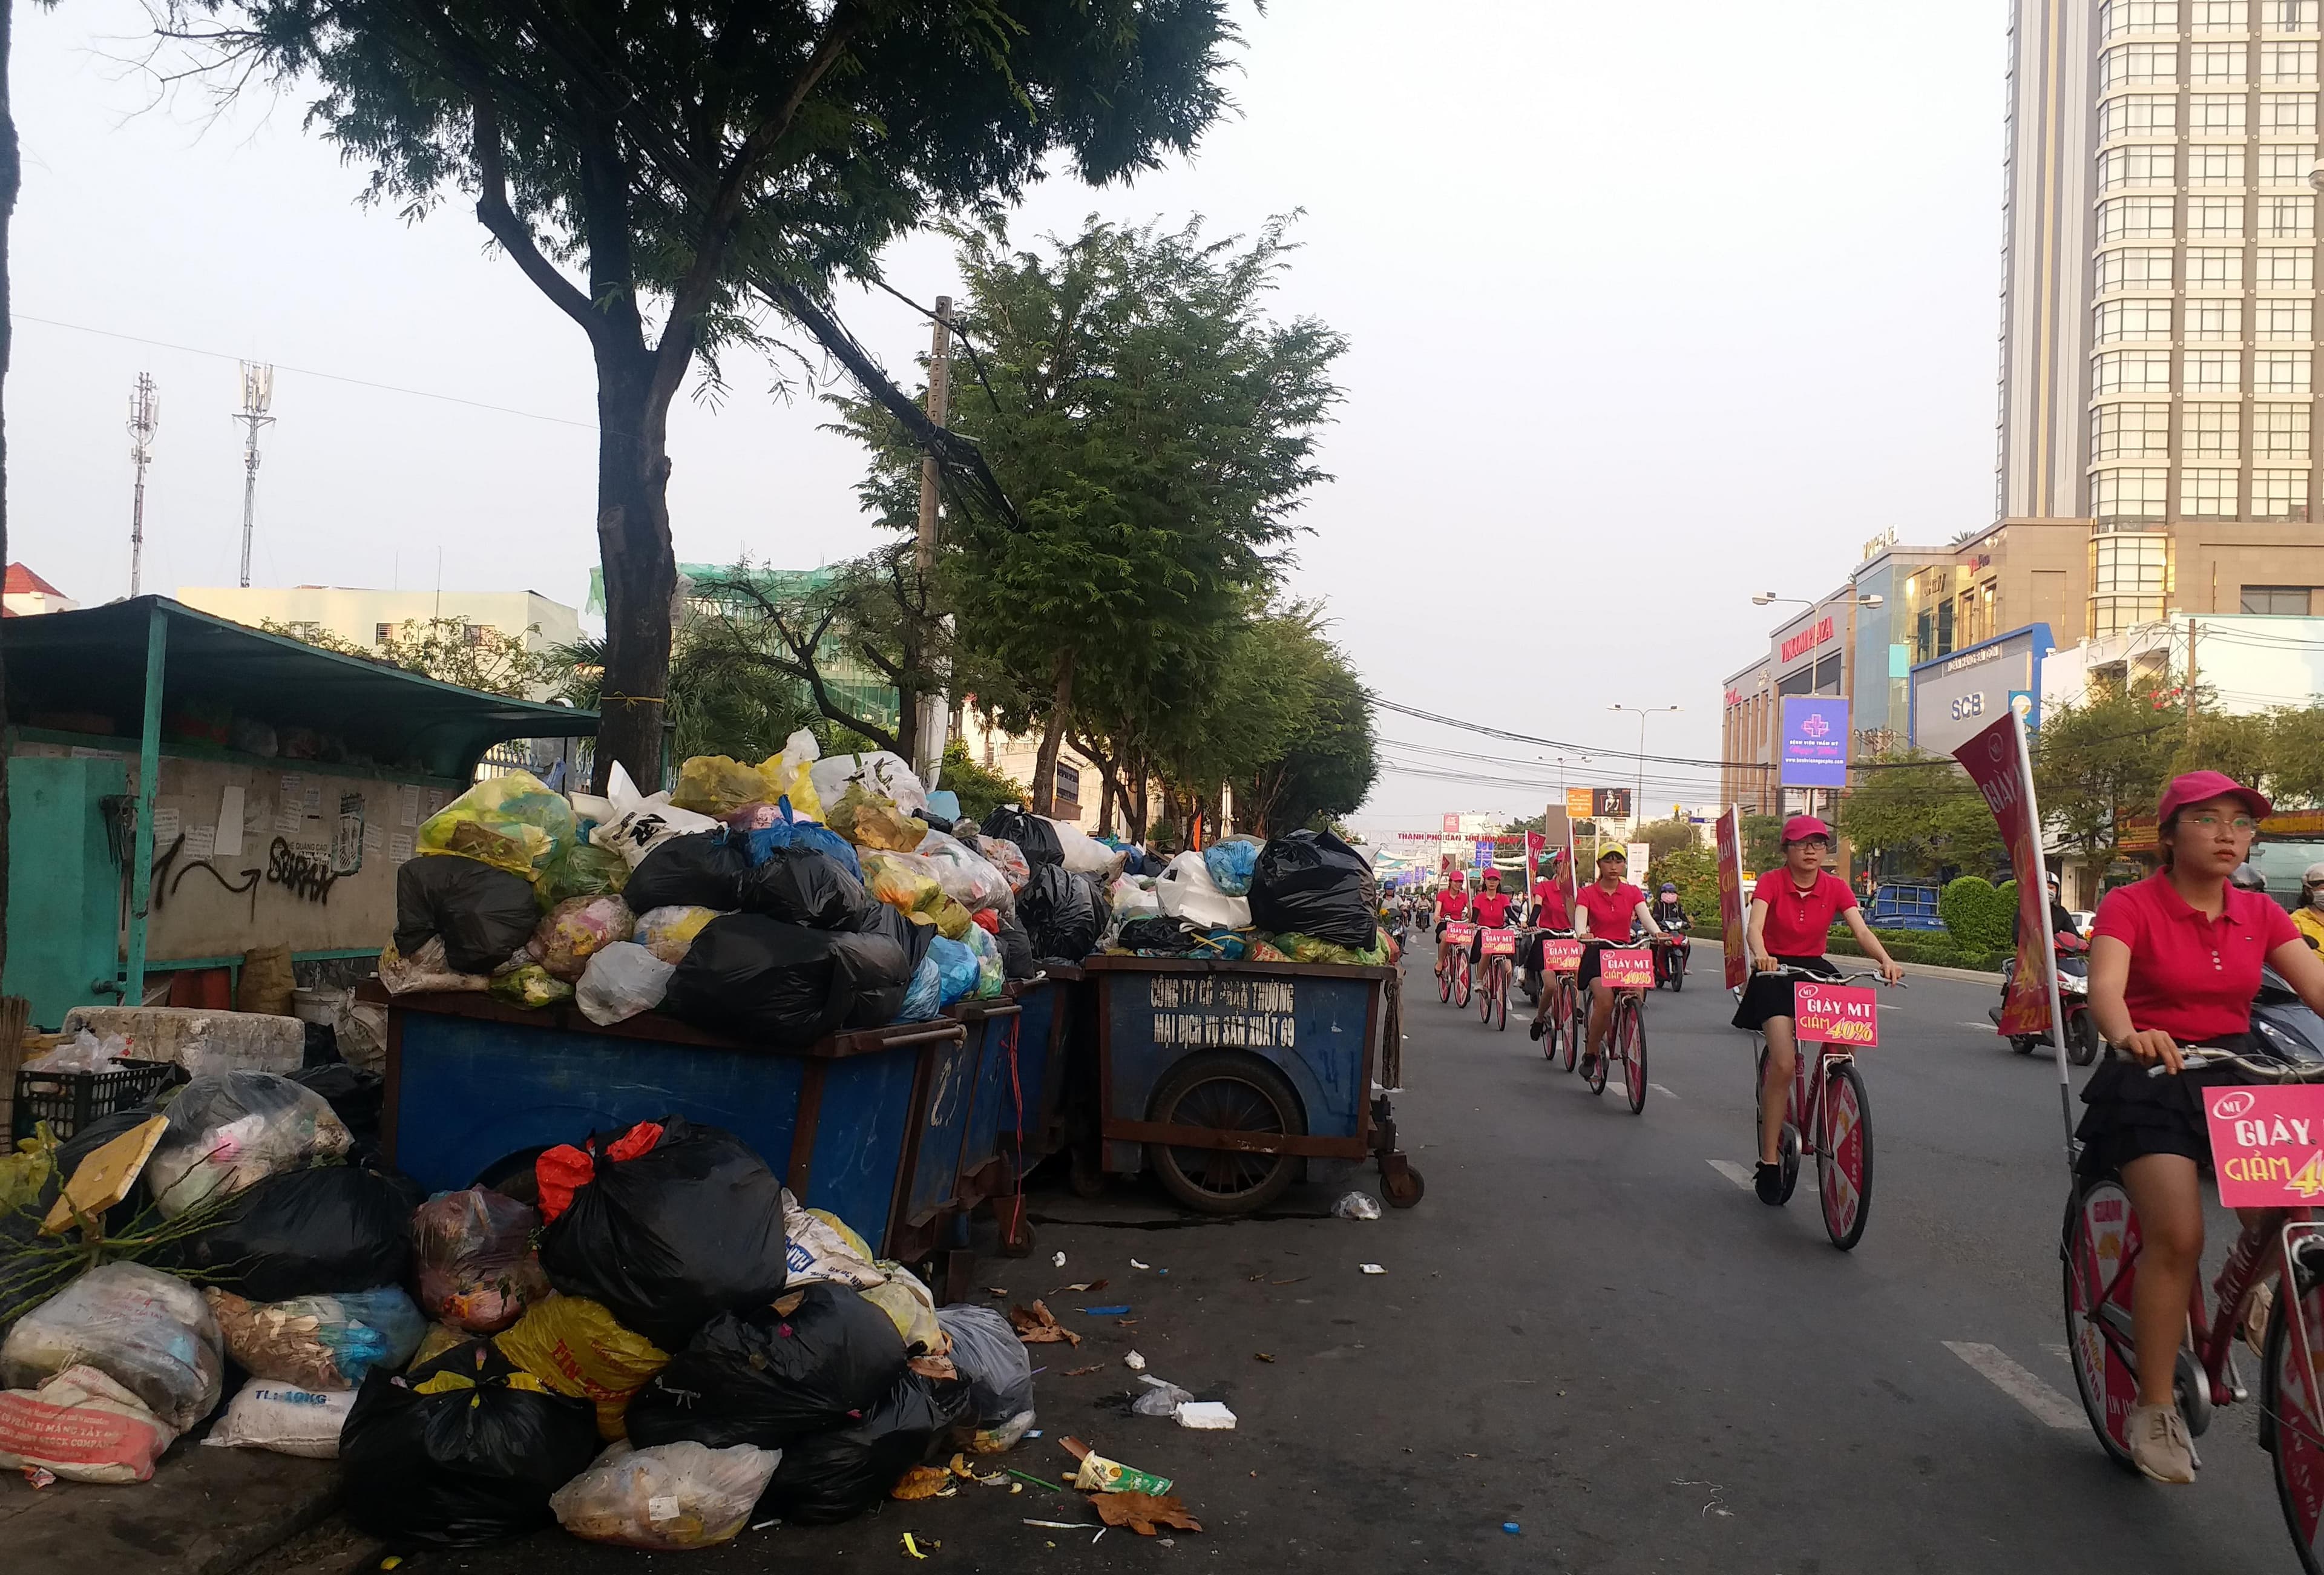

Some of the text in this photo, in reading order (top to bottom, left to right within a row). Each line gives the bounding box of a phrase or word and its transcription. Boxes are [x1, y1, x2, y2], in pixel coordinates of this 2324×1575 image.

[1781, 616, 1834, 663] VINCOM PLAZA
[1952, 692, 1984, 722] SCB
[1549, 946, 1568, 955] GIÀY
[1607, 958, 1650, 968] GIÀY MT
[1151, 973, 1179, 1008] CÔNG
[1182, 979, 1196, 1007] TY
[1604, 968, 1652, 985] GIẢM 40%
[1807, 998, 1873, 1018] GIÀY MT
[1154, 1008, 1295, 1050] MẠI DỊCH VỤ SẢN XUẤT 69
[1800, 1013, 1874, 1042] GIẢM 40%
[2222, 1100, 2241, 1113] MT
[2234, 1113, 2311, 1146] GIÀY
[2224, 1149, 2293, 1181] GIẢM
